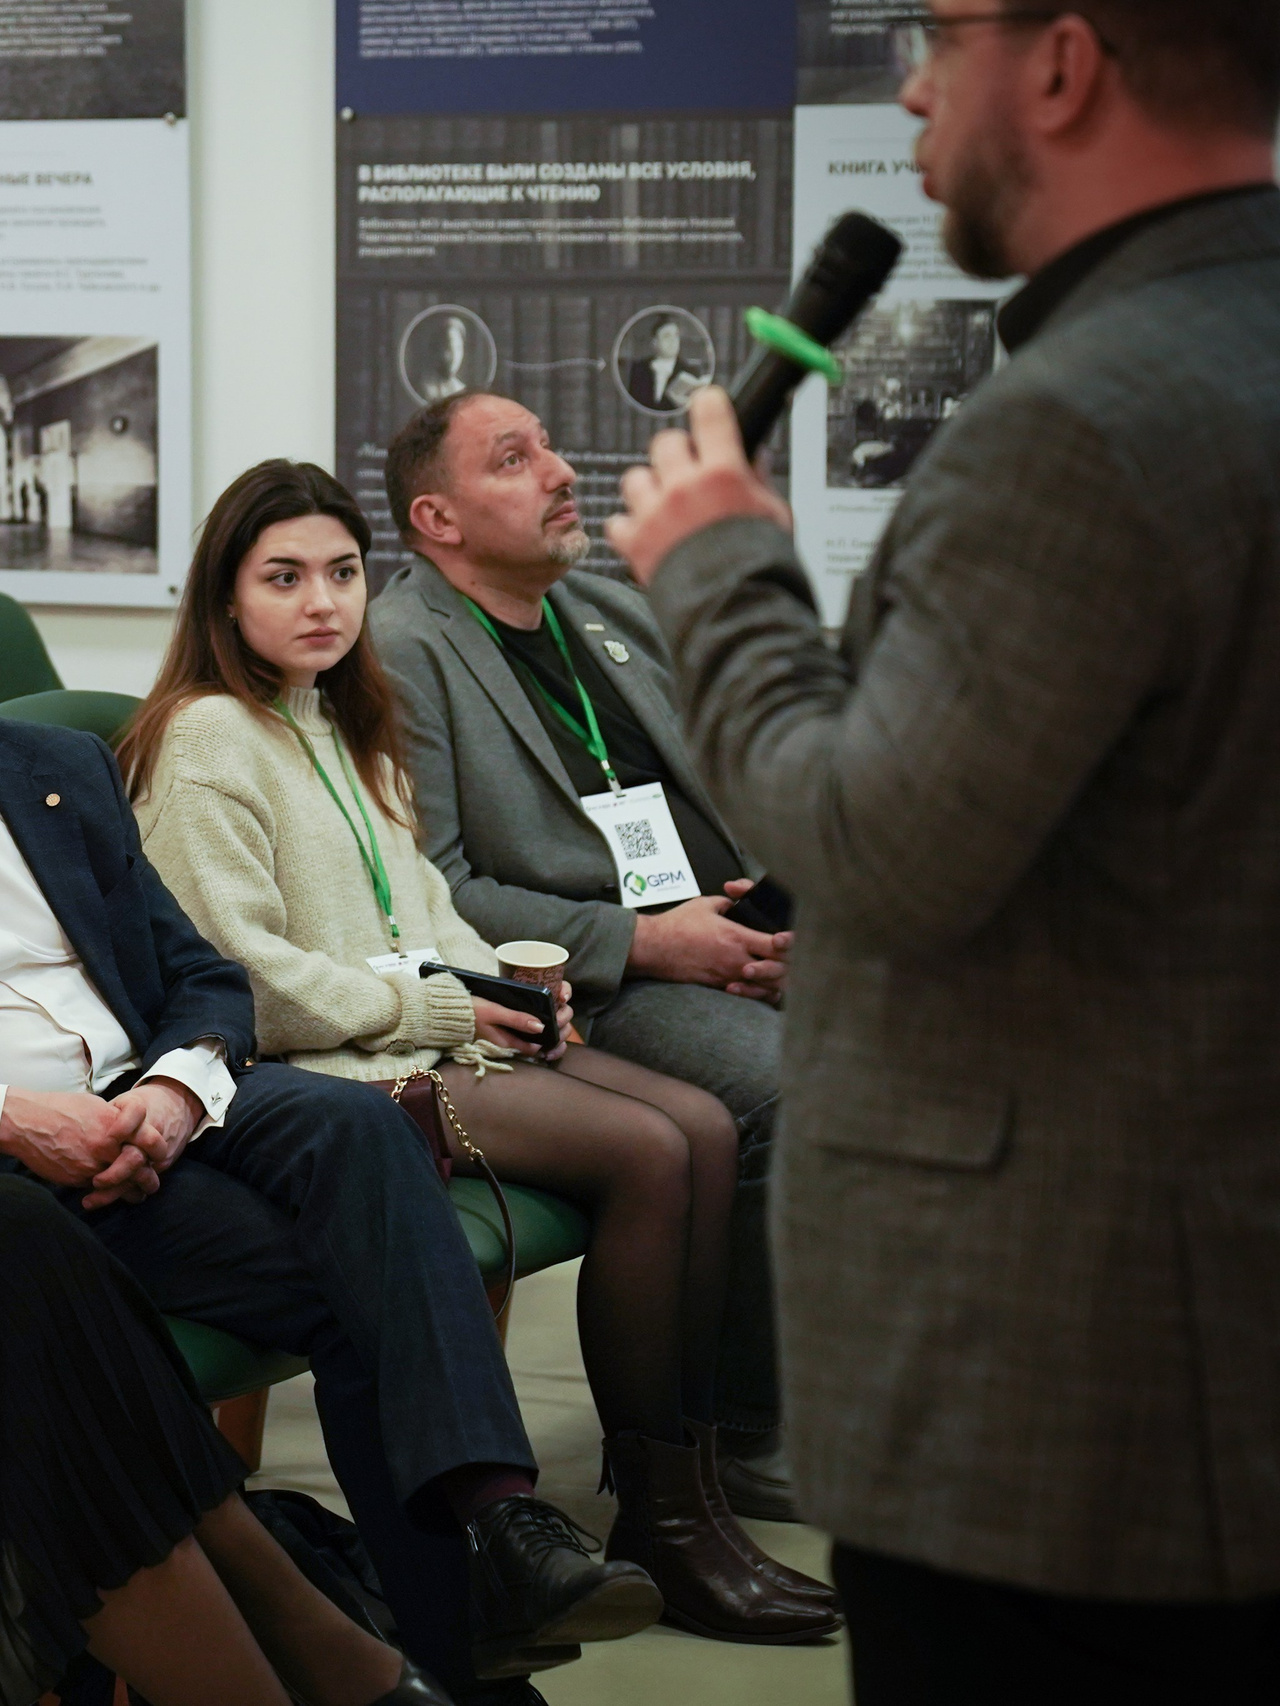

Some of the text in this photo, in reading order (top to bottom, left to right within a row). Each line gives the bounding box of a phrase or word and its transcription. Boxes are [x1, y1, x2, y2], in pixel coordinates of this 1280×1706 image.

[358, 161, 757, 182] В БИБЛИОТЕКЕ БЫЛИ СОЗДАНЫ ВСЕ УСЛОВИЯ,
[828, 160, 887, 174] КНИГА
[34, 172, 93, 186] ВЕЧЕРА
[358, 185, 601, 203] РАСПОЛАГАЮЩИЕ К ЧТЕНИЮ
[646, 869, 686, 887] GPM
